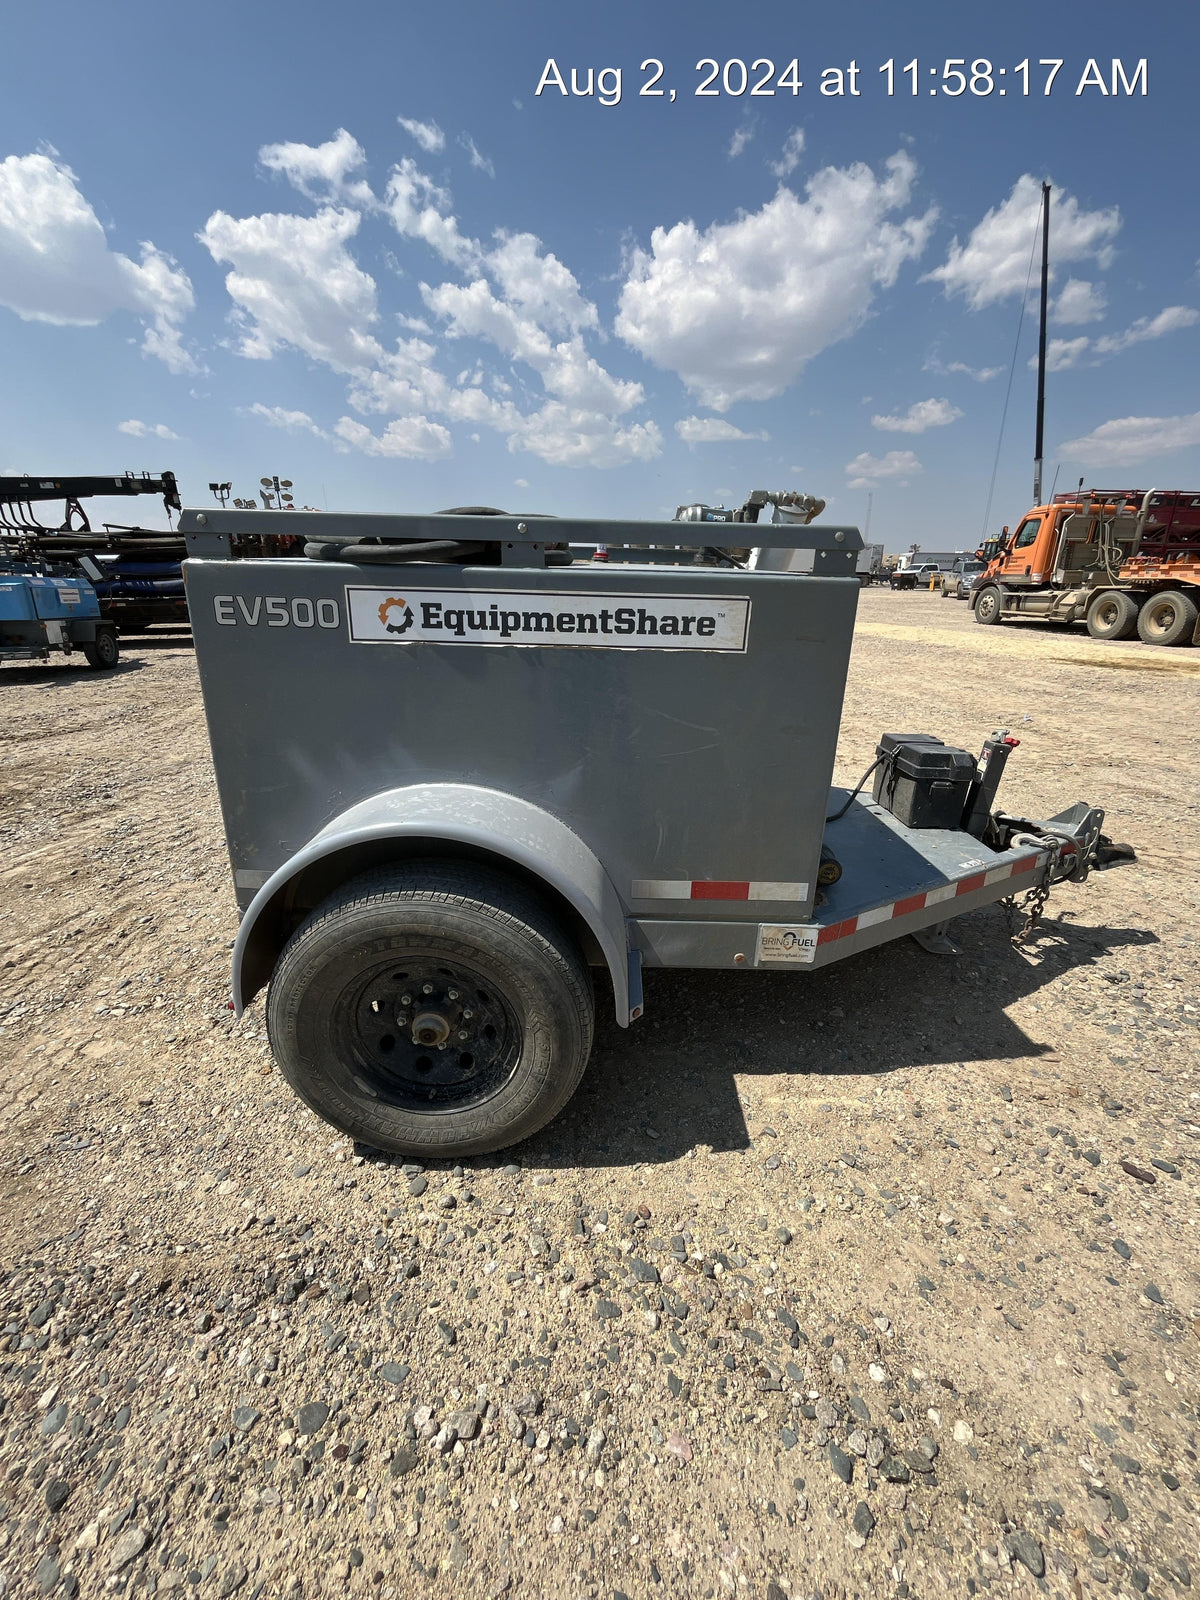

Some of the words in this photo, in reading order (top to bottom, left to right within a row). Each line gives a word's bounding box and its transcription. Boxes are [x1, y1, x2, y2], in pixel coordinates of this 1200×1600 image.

[212, 593, 341, 630] EV500
[420, 601, 716, 638] EquipmentShare
[761, 936, 790, 947] BRING
[791, 938, 816, 947] FUEL
